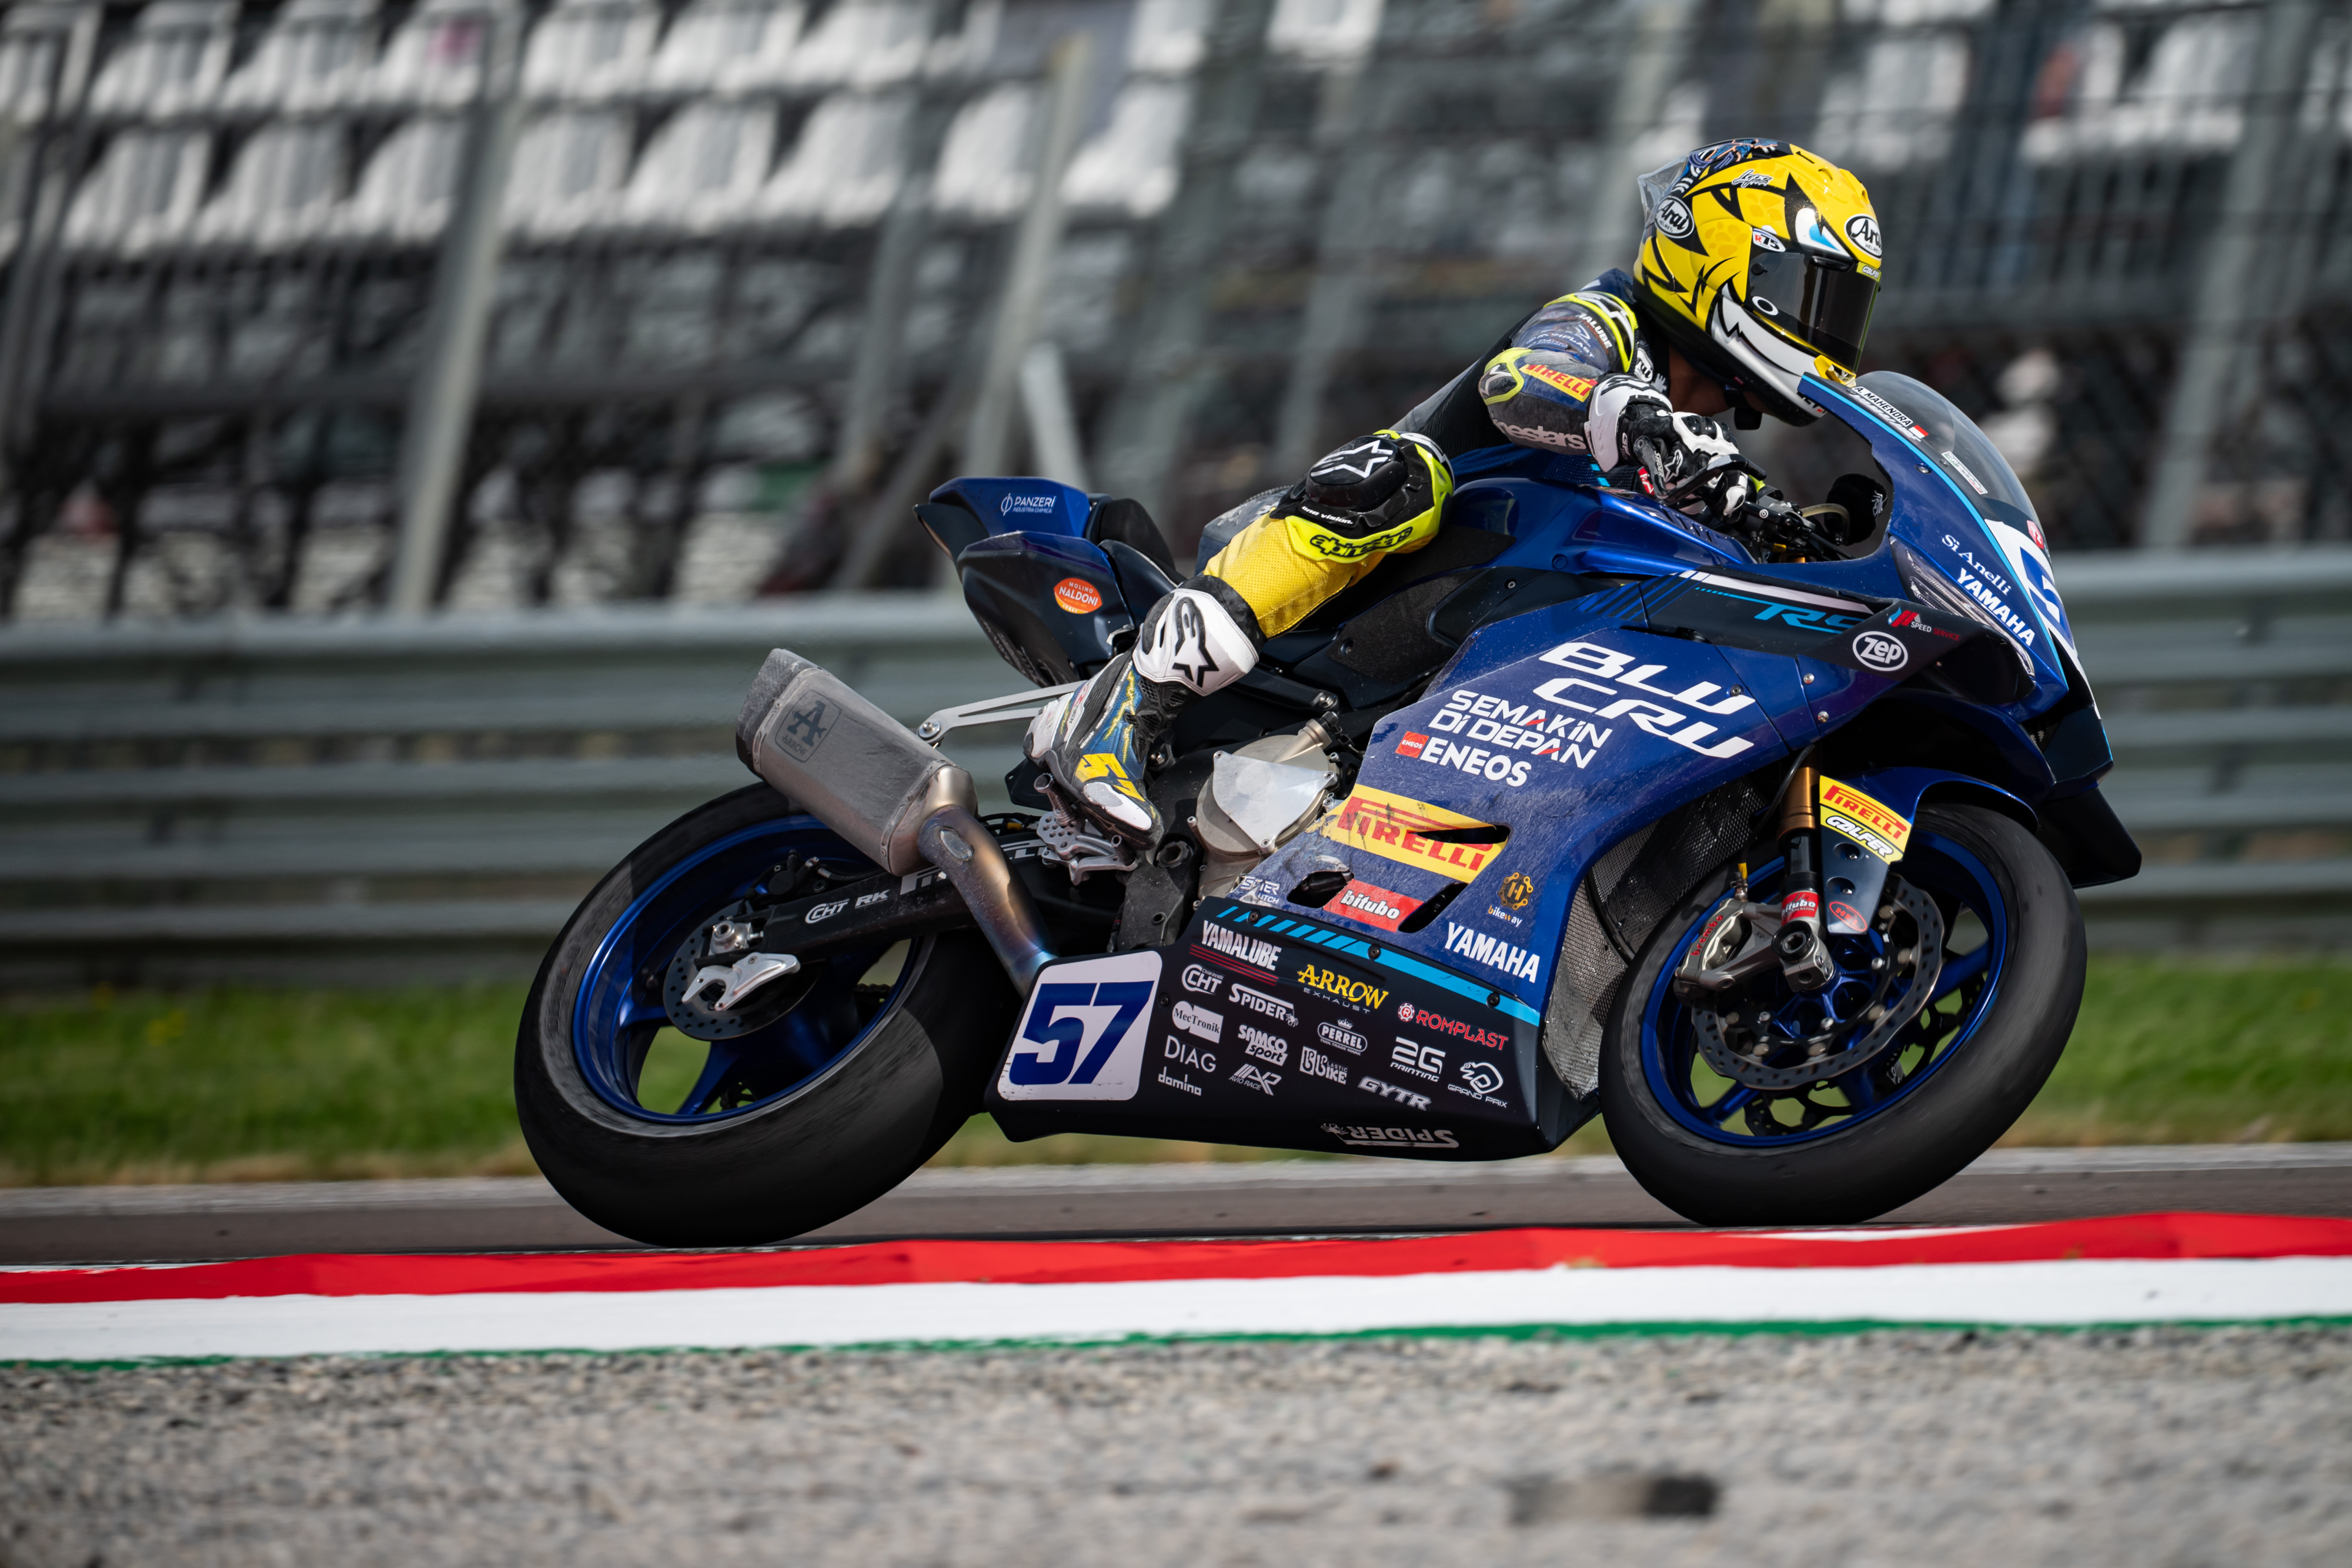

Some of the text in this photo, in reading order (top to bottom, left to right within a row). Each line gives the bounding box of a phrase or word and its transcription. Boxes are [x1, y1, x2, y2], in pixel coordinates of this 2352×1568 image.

[1660, 200, 1690, 230] Arai
[1851, 219, 1881, 250] Ara
[1865, 392, 1912, 426] MAHENDRA
[1301, 506, 1320, 516] one
[1310, 526, 1414, 558] alpinestars
[1942, 534, 1960, 552] Si
[1959, 552, 2012, 596] Anelli
[1059, 586, 1098, 607] NALDONI
[1069, 581, 1093, 594] MOLINO
[1957, 568, 2035, 646] YAMAHA
[1910, 621, 1960, 641] SPEED SERVICE
[1539, 642, 1756, 715] BLU
[1445, 690, 1613, 748] SEMAKIN
[1533, 678, 1754, 758] CRU
[781, 735, 808, 755] ARROW
[1466, 718, 1597, 768] DEPAN
[1402, 737, 1532, 787] ENEOS ENEOS
[1823, 785, 1907, 840] PIRELLI
[1337, 796, 1493, 871] PIRELLI
[1826, 815, 1894, 858] GALFER
[811, 902, 848, 920] CHT
[855, 890, 891, 907] RK
[1340, 890, 1400, 920] bitubo
[1488, 905, 1522, 927] bikeway
[1835, 907, 1859, 928] HEL
[1202, 920, 1282, 971] YAMALUBE
[1690, 915, 1723, 956] brembo
[1445, 922, 1540, 984] YAMAHA
[1187, 969, 1222, 994] CHT
[1202, 968, 1224, 980] Chiaravalli
[1297, 964, 1388, 1009] ARROW
[1229, 983, 1294, 1021] SPIDER
[1304, 988, 1370, 1014] EXHAUST
[1008, 981, 1155, 1085] 57
[1173, 1008, 1220, 1034] MecTronik
[1416, 1009, 1508, 1050] ROMPLAST
[1238, 1024, 1288, 1053] SAMCO
[1321, 1025, 1362, 1049] PERREL
[1332, 1042, 1347, 1051] TRADE
[1164, 1035, 1217, 1073] DIAG
[1249, 1044, 1284, 1062] sport
[1392, 1037, 1446, 1074] 2G
[1158, 1066, 1202, 1096] domino
[1229, 1075, 1262, 1091] AVIO RACE
[1389, 1061, 1439, 1082] PAINTING
[1358, 1076, 1431, 1111] GYTR
[1448, 1084, 1508, 1109] GRAND PRIX
[1345, 1126, 1459, 1148] SPIDER
